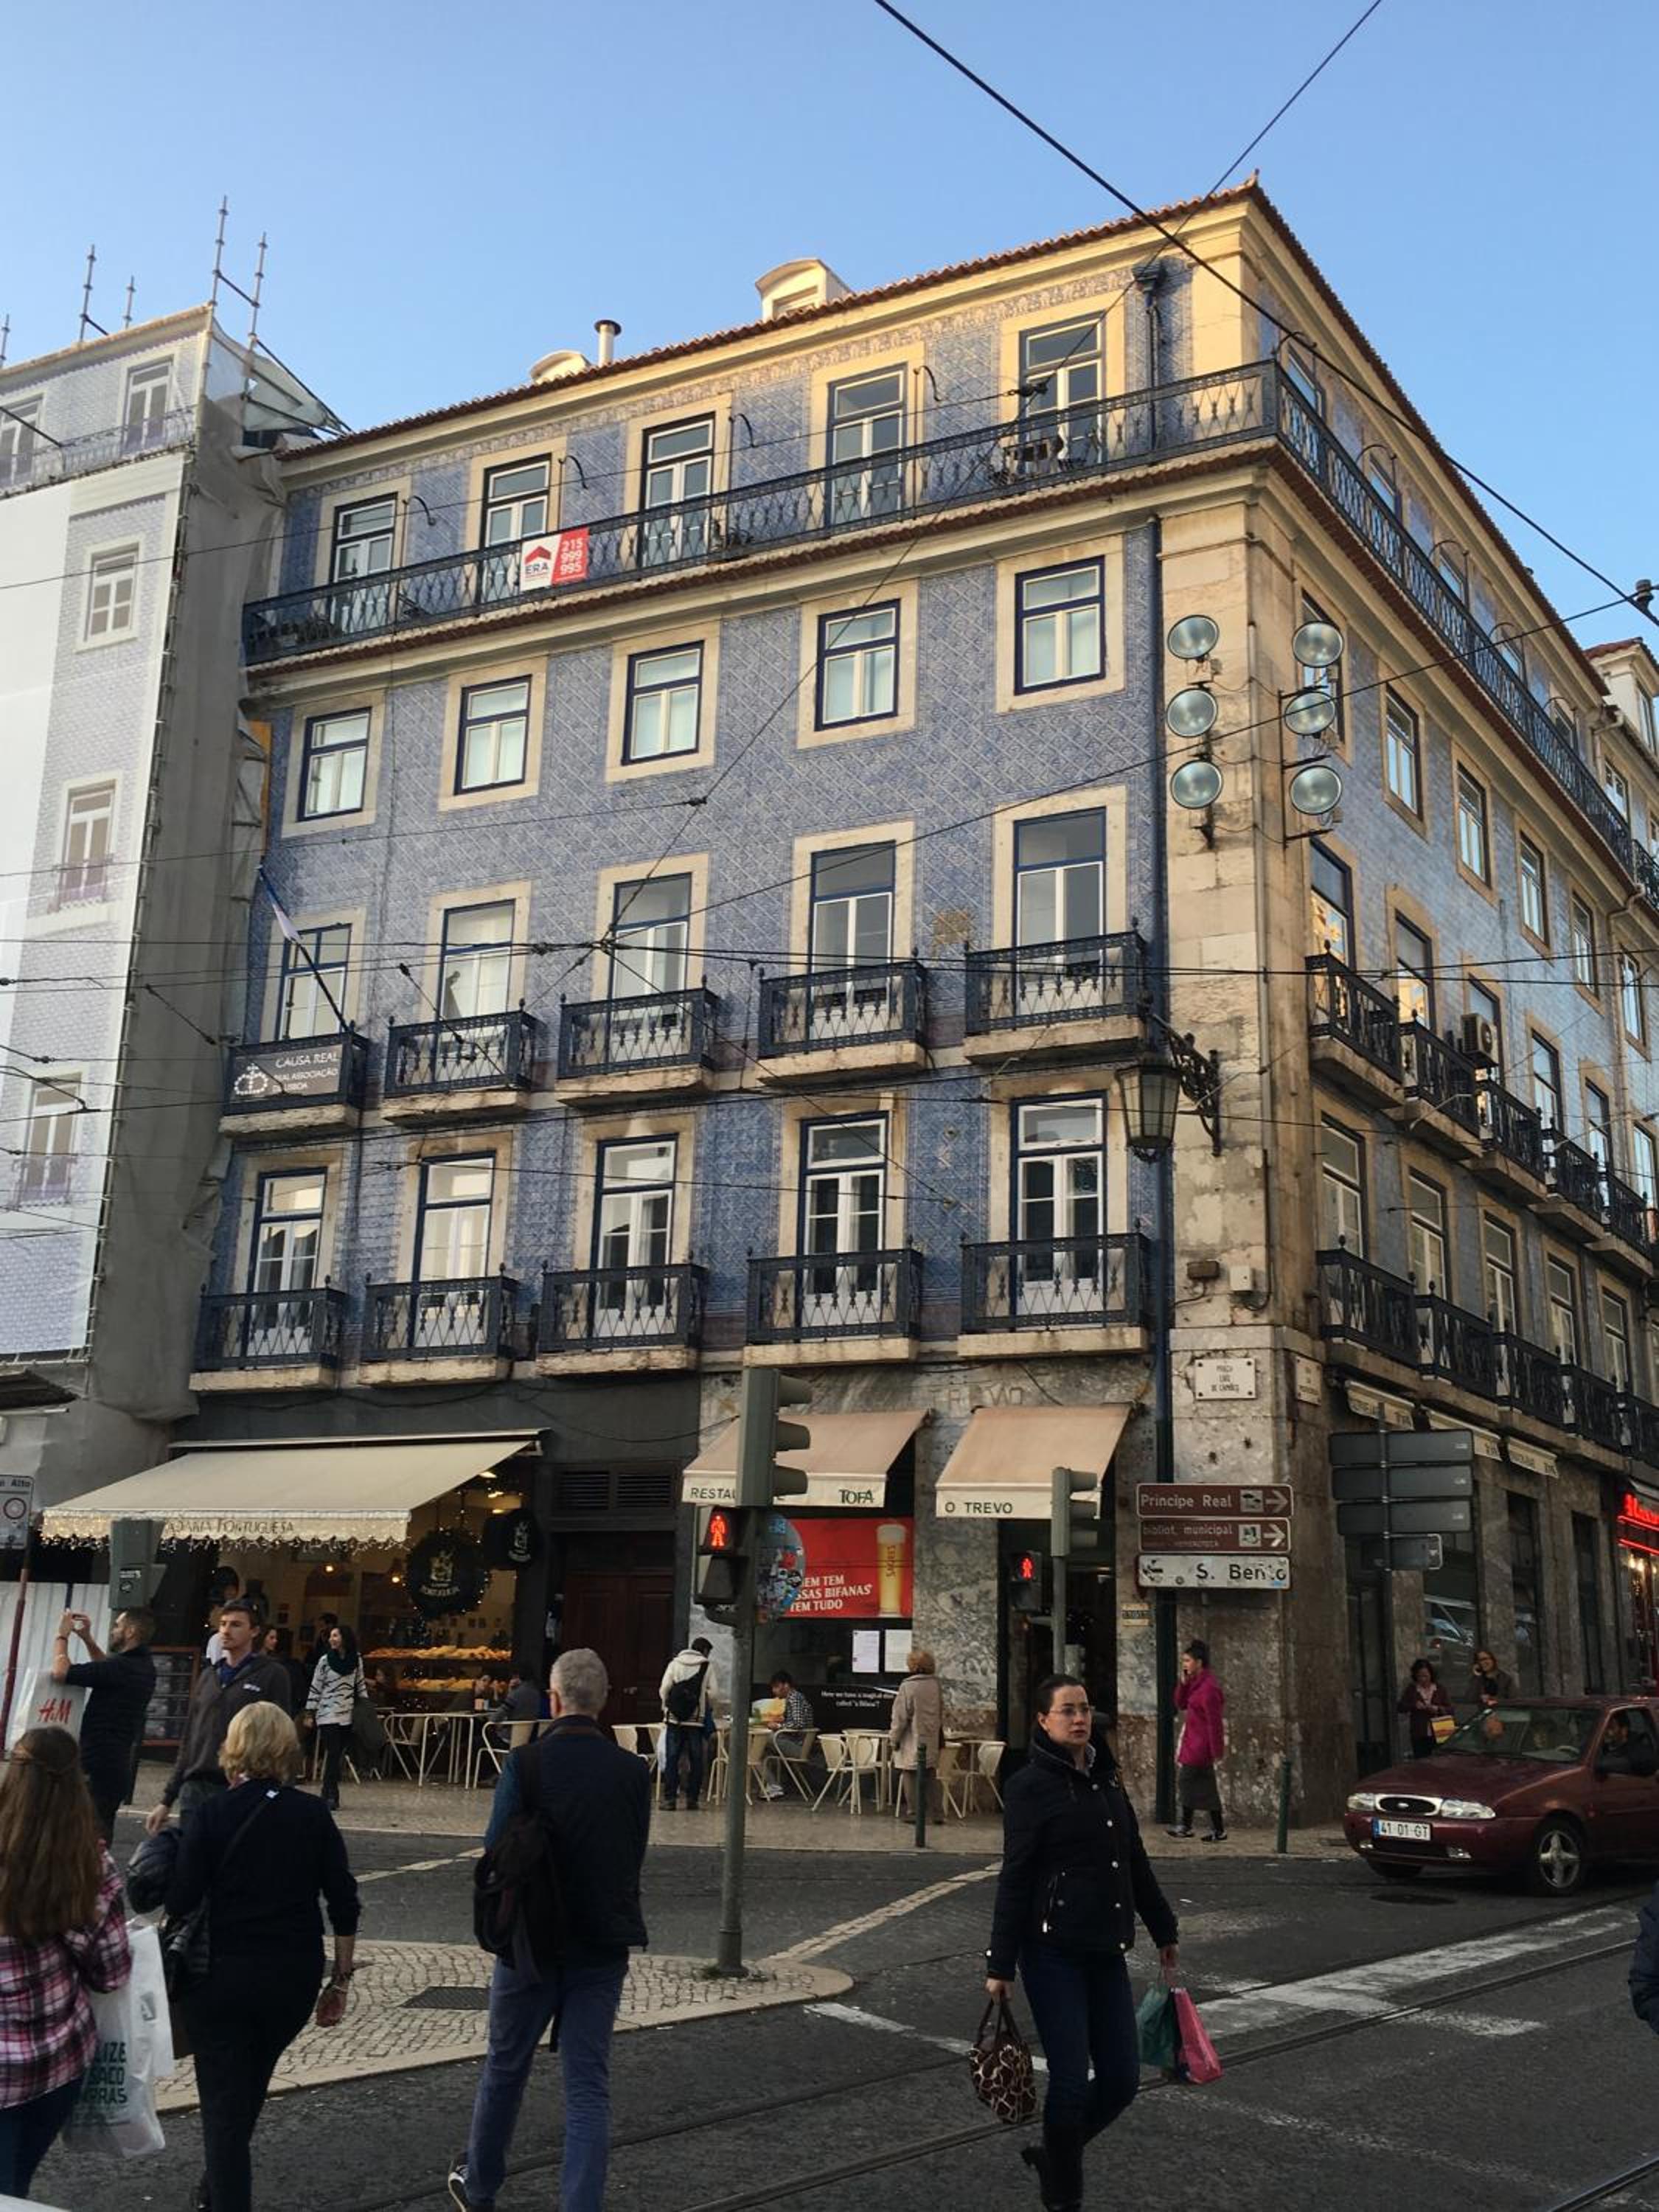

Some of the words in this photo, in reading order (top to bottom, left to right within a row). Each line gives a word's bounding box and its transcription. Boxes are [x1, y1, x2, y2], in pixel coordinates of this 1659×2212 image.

[275, 1055, 311, 1068] CAUSA
[313, 1051, 341, 1063] REAL
[838, 1489, 874, 1505] TOFA
[1203, 1494, 1232, 1509] Real
[945, 1501, 956, 1513] O
[964, 1501, 1013, 1514] TREVO
[1183, 1523, 1234, 1537] municipal
[1196, 1562, 1215, 1580] S.
[824, 1574, 844, 1586] TEM
[824, 1584, 872, 1598] BIFANAS
[790, 1602, 810, 1613] TEM
[813, 1599, 844, 1610] TUDO
[38, 1698, 72, 1724] H&M
